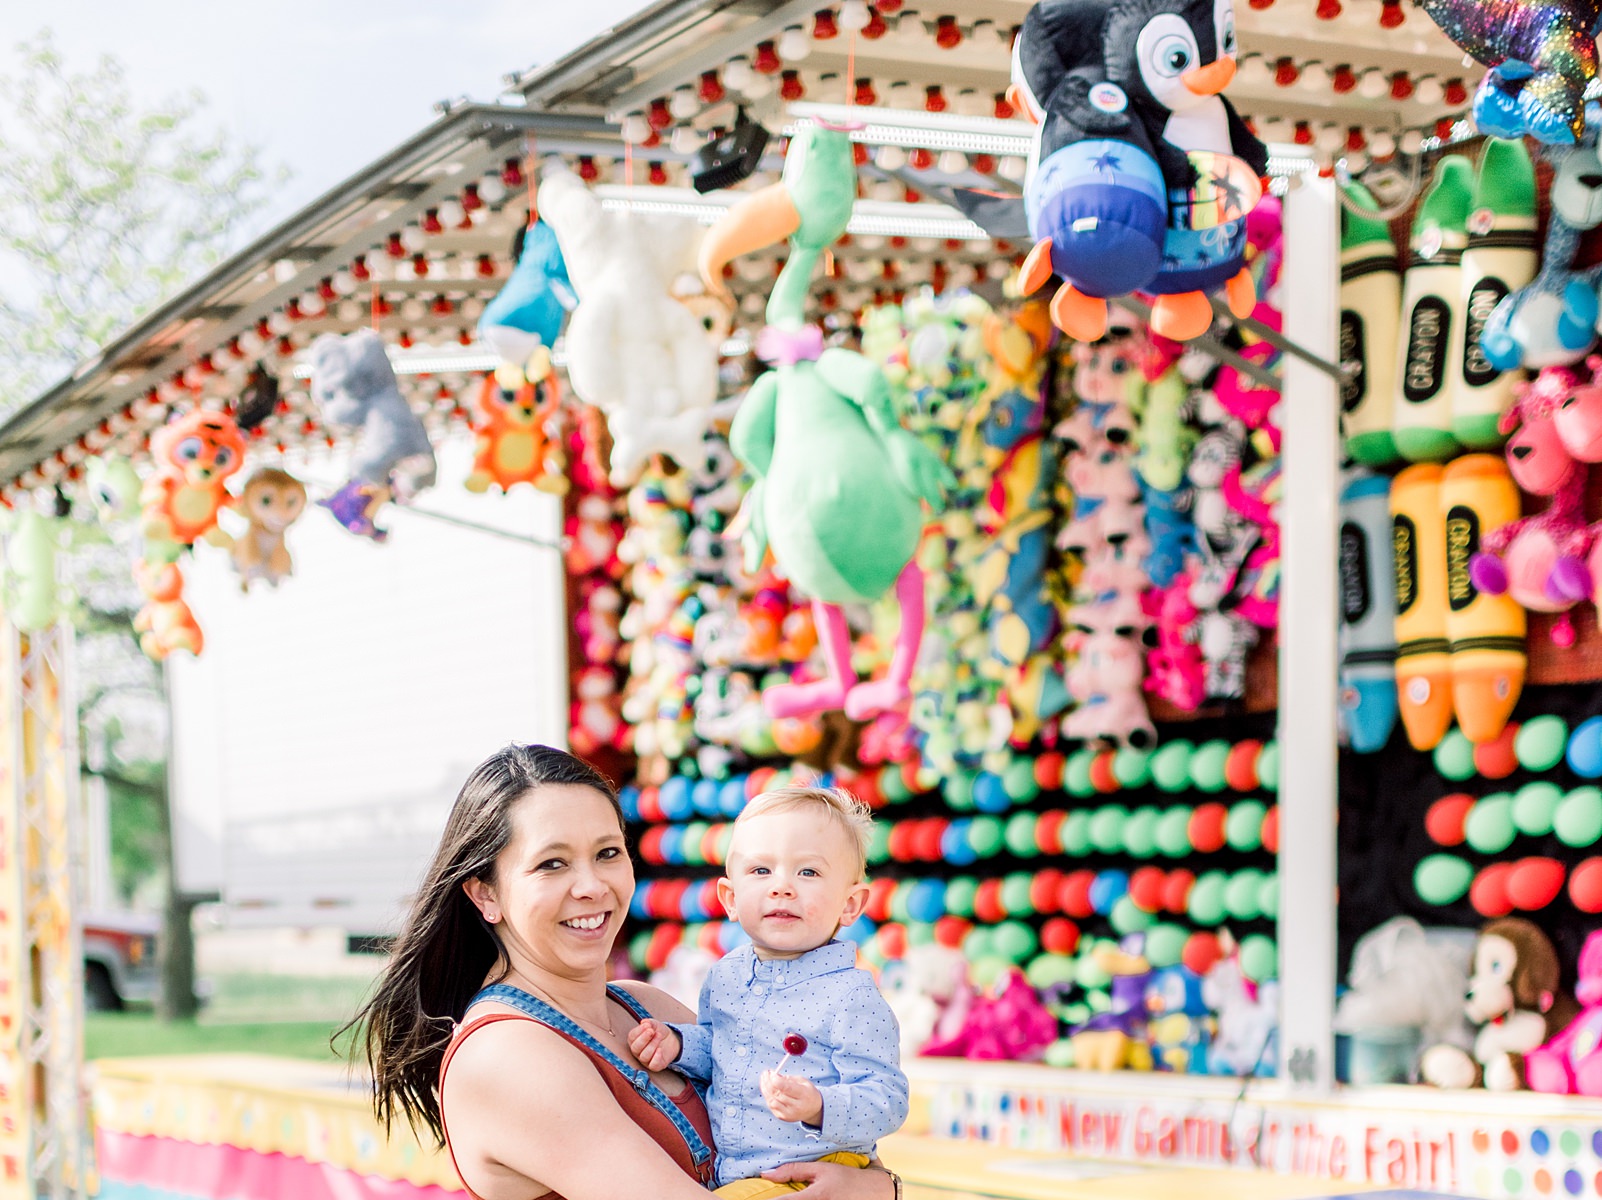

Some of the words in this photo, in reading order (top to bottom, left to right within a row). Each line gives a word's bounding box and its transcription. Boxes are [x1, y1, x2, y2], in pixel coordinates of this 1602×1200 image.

[1406, 308, 1441, 389] CRAYON
[1446, 518, 1471, 601] CRAYON
[1060, 1100, 1122, 1151] New
[1291, 1121, 1347, 1180] the
[1364, 1126, 1458, 1189] Fair!
